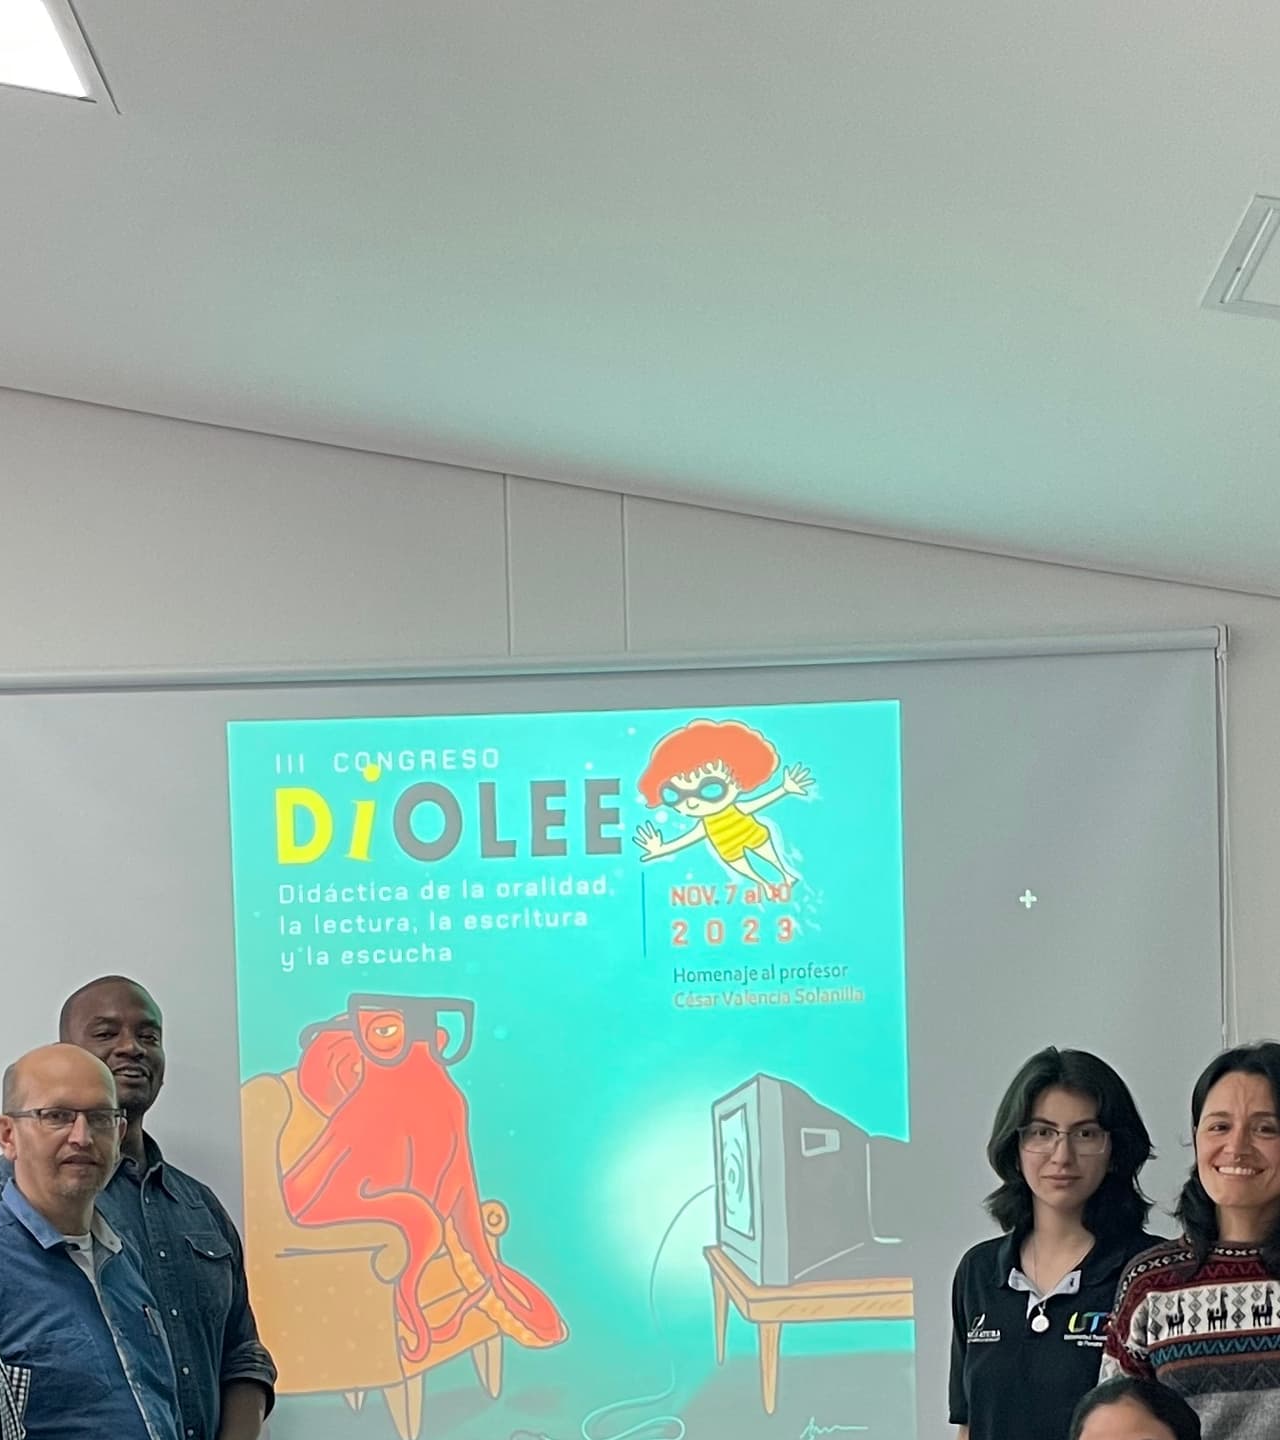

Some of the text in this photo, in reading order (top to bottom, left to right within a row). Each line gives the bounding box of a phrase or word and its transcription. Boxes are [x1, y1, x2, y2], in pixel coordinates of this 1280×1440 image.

[274, 747, 500, 775] III CONGRESO
[278, 881, 409, 905] Didáctica
[421, 880, 451, 901] de
[462, 879, 485, 899] la
[724, 884, 738, 905] 7
[743, 882, 762, 904] al
[279, 908, 589, 936] la lectura, la escritura
[280, 943, 454, 973] y la escucha
[673, 961, 849, 986] Homenaje al profesor
[673, 985, 865, 1009] César Valencia Solanilla
